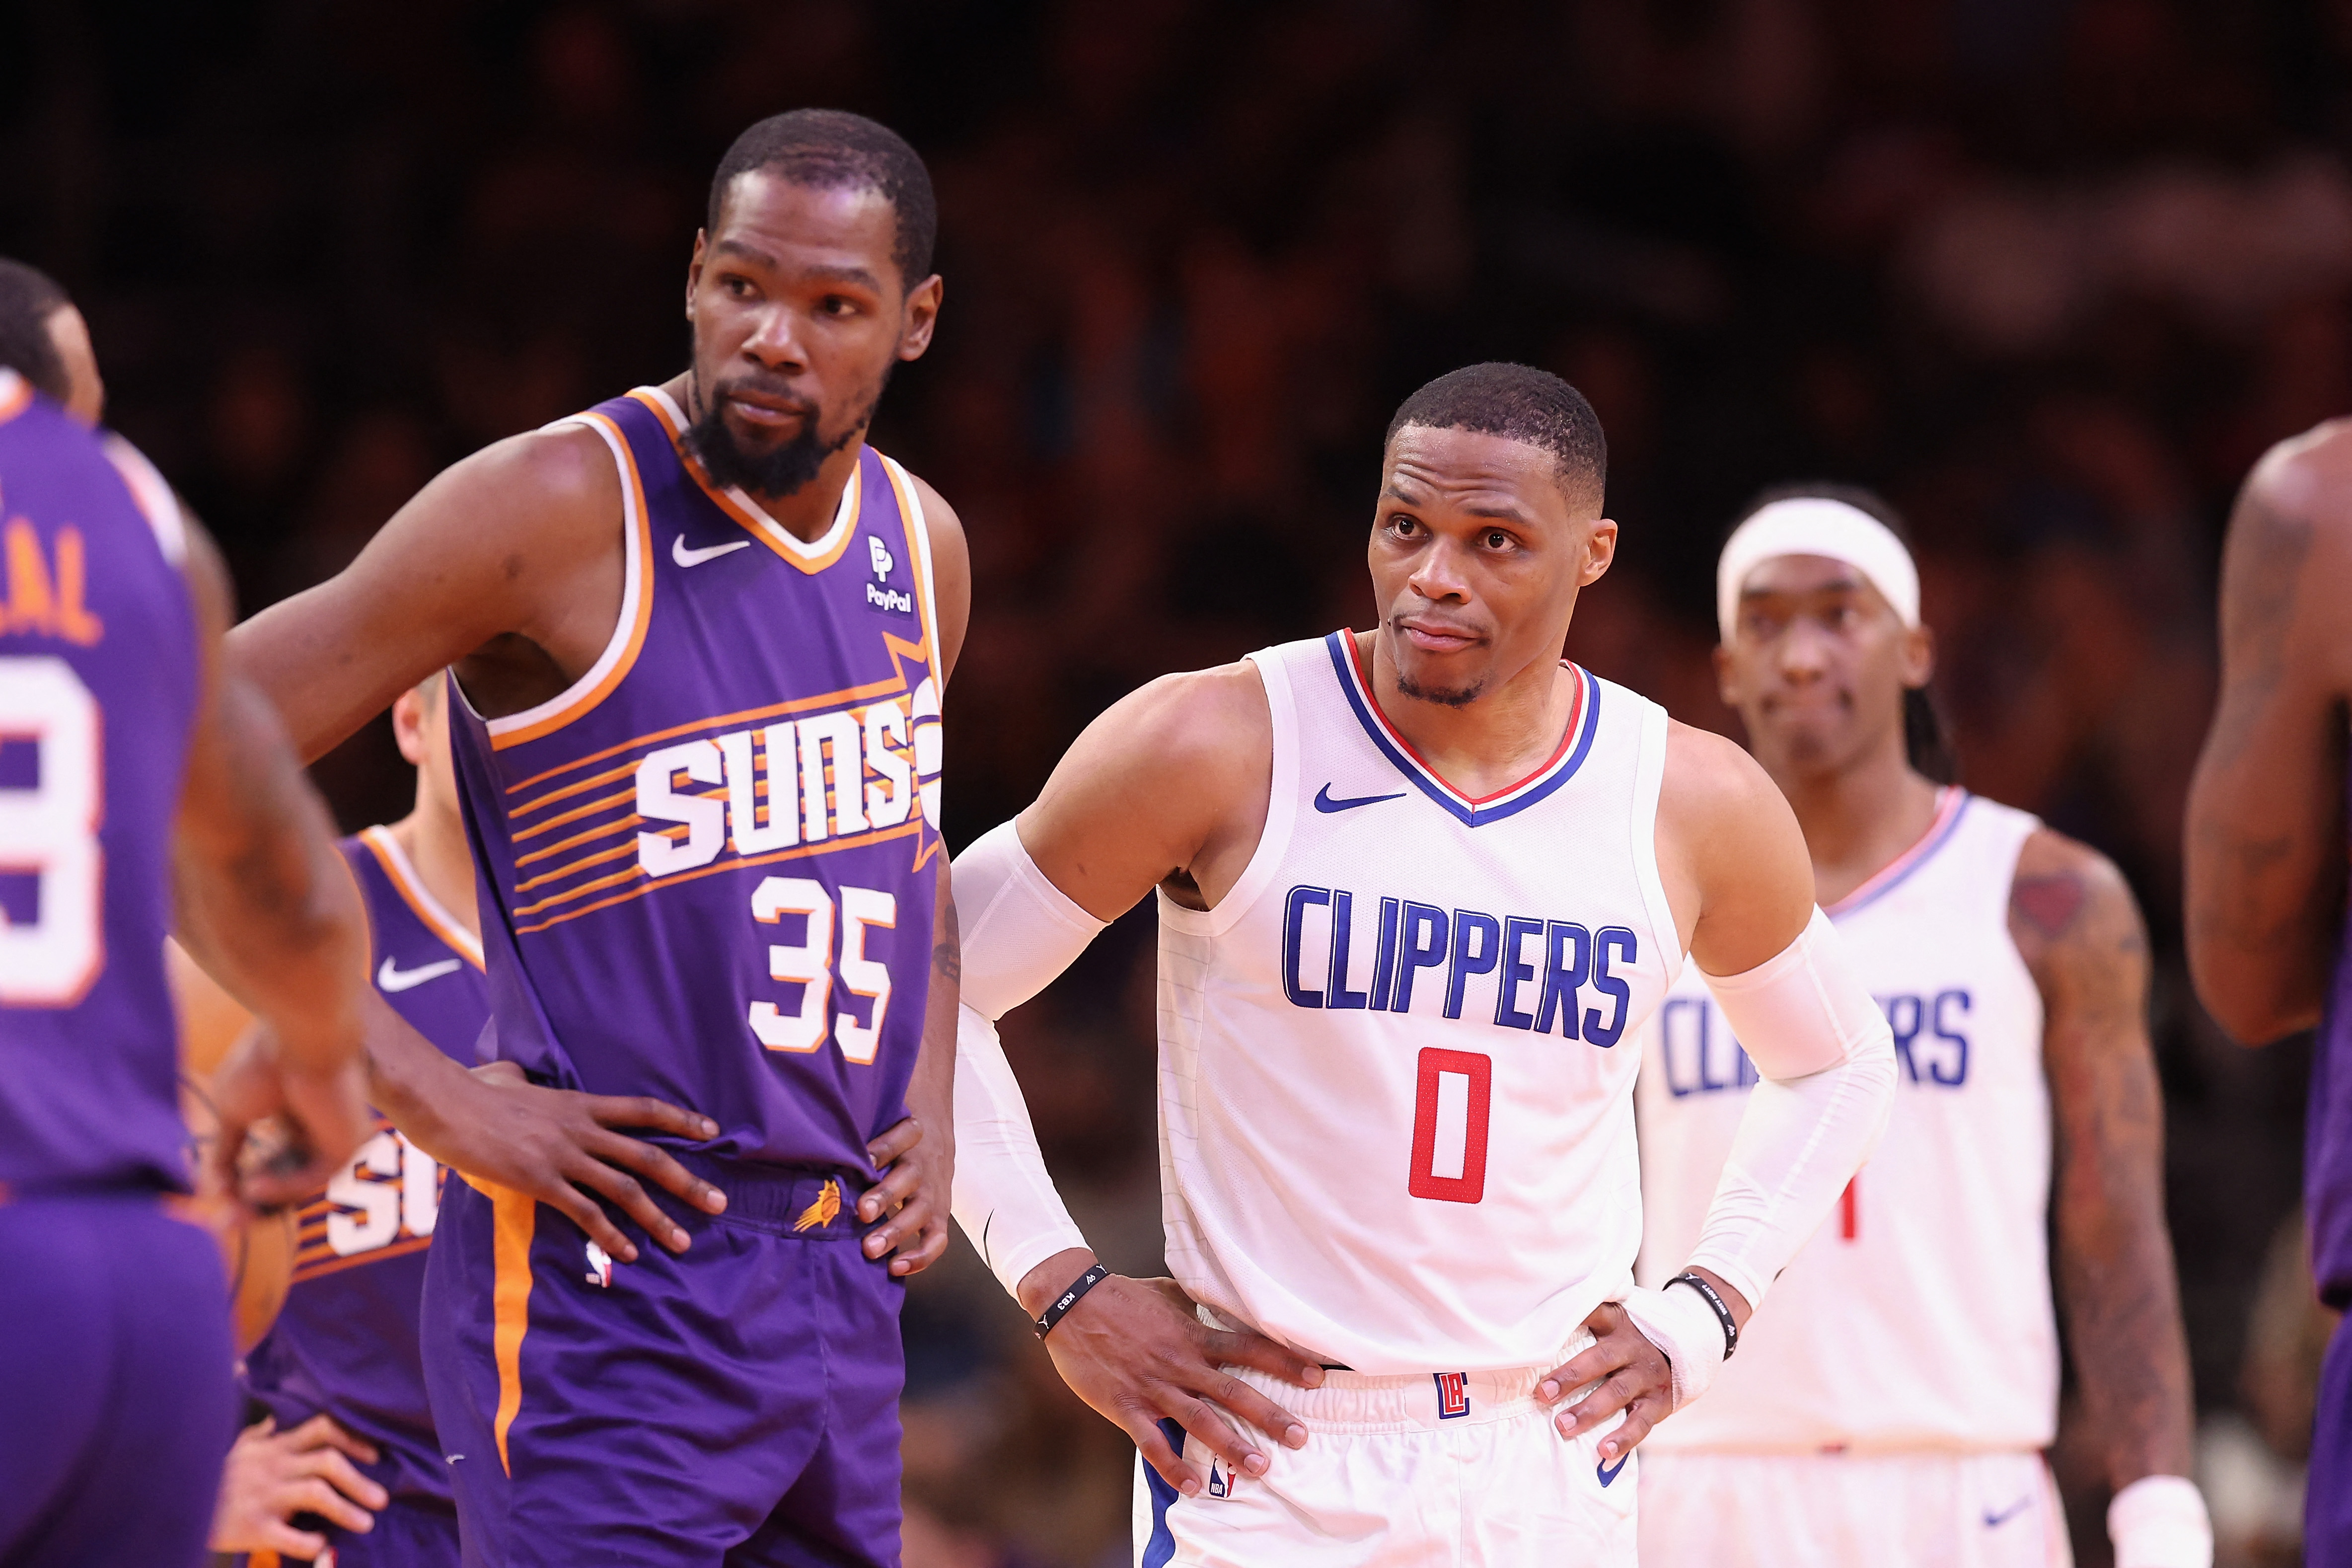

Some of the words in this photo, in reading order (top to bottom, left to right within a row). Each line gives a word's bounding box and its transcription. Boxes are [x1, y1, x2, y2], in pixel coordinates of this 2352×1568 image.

[866, 583, 912, 612] PayPal
[636, 700, 913, 879] SUNS
[748, 875, 897, 1066] 35
[1281, 884, 1637, 1048] CLIPPERS
[1408, 1046, 1492, 1204] 0
[1057, 1291, 1076, 1310] KB3
[1715, 1299, 1728, 1316] WHY
[1210, 1483, 1223, 1494] NBA
